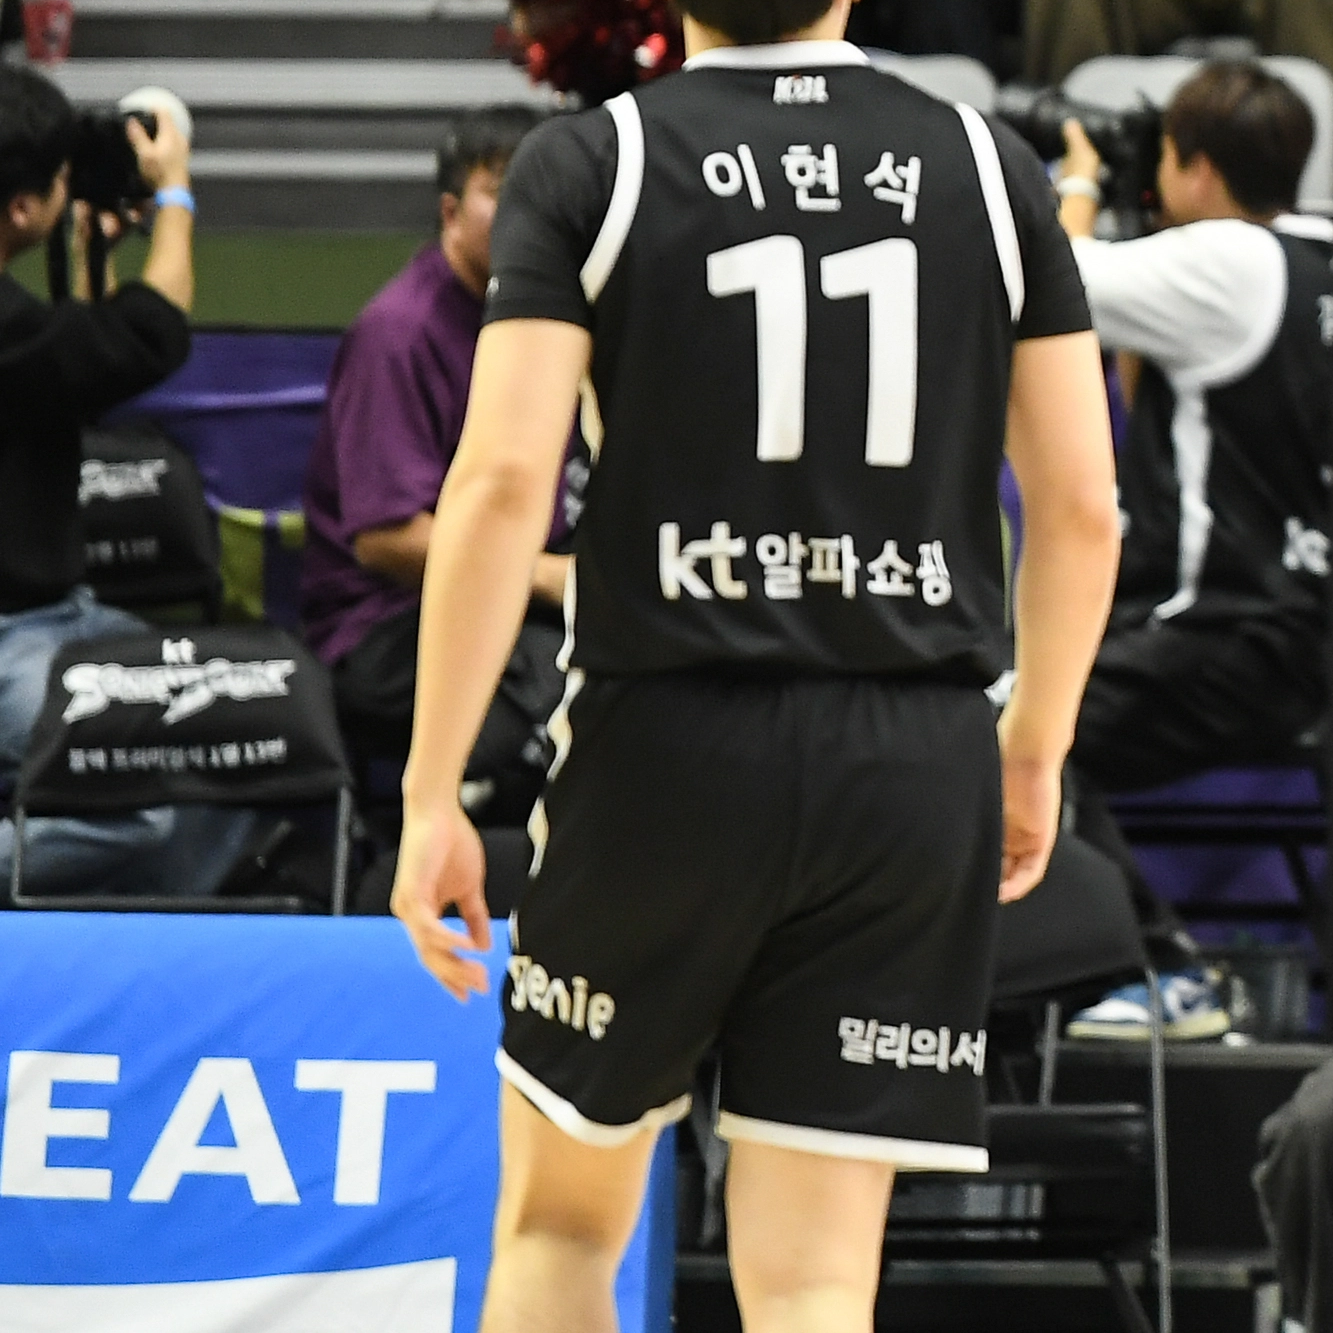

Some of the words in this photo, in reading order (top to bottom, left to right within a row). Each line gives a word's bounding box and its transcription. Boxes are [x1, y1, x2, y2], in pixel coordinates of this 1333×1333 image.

[702, 143, 922, 225] 이현석
[706, 234, 919, 468] 11
[508, 954, 616, 1041] genie
[0, 1050, 437, 1206] EAT
